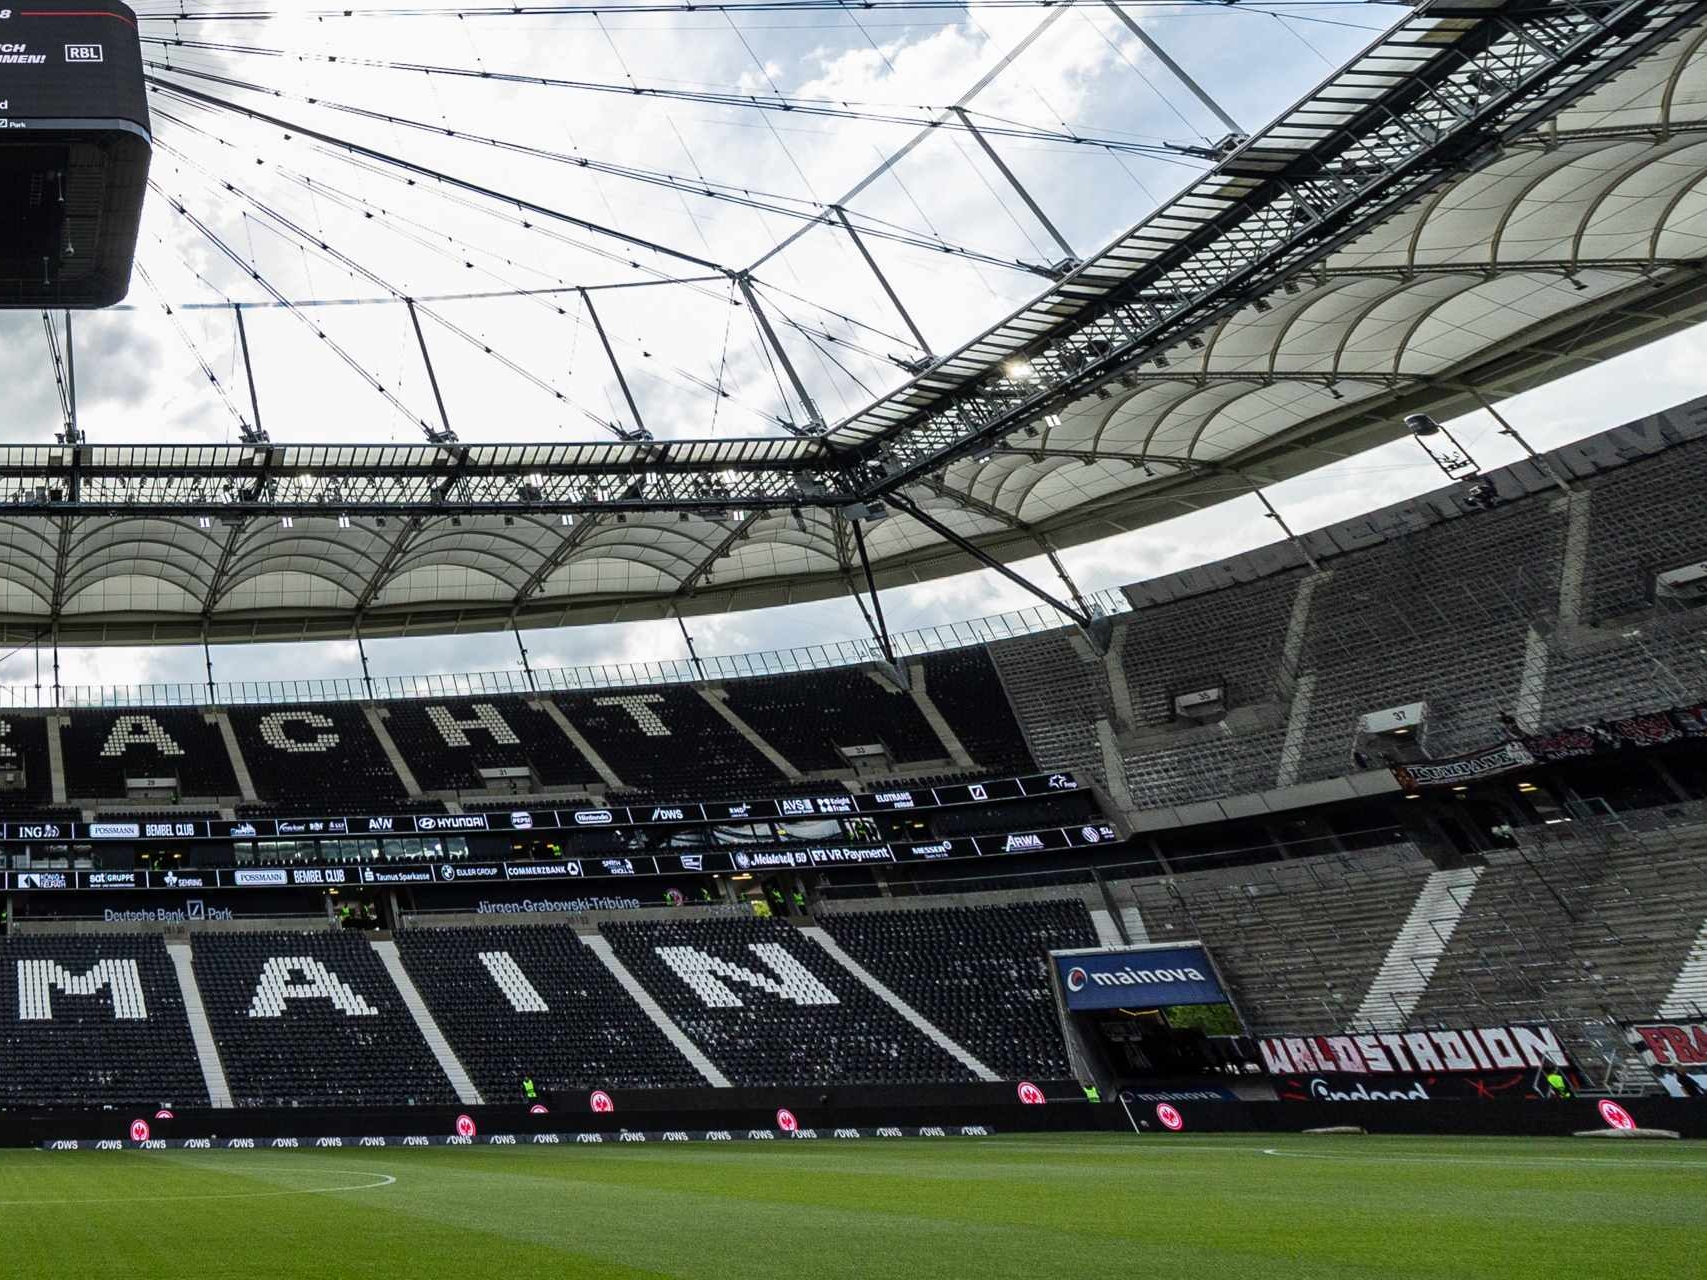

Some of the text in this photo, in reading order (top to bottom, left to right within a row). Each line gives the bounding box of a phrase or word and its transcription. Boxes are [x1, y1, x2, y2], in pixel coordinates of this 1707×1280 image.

[70, 46, 98, 60] RBL
[9, 121, 26, 129] Park
[1392, 710, 1407, 721] 37
[875, 792, 912, 803] ELOTRANS
[783, 799, 805, 811] AVS
[660, 808, 683, 819] DWS
[437, 817, 484, 829] HYUNDAI
[19, 826, 42, 838] ING
[94, 824, 195, 838] POSSMANN BEMBEL CLUB
[1005, 834, 1045, 852] ARWA
[826, 847, 891, 862] VR Payment
[911, 845, 947, 855] MESSER
[240, 869, 345, 883] POSSMANN BEMBEL CLUB
[456, 867, 498, 877] EULER GROUP
[508, 865, 567, 876] COMMERZBANK
[107, 873, 135, 883] GRUPPE
[376, 872, 430, 883] Taunus Sparkasse
[478, 896, 640, 913] Jürgen-Grabowski-Tribüne
[104, 907, 233, 922] Deutsche Bank Park
[18, 943, 840, 1020] MAIN
[1090, 966, 1206, 987] mainova
[1258, 1026, 1571, 1074] WALDSTADION
[1137, 1091, 1223, 1101] mainova
[58, 1127, 988, 1149] DWS DWS DWS DWS DWS DWS DWS DWS DWS DWS DWS DWS DWS DWS DWS
